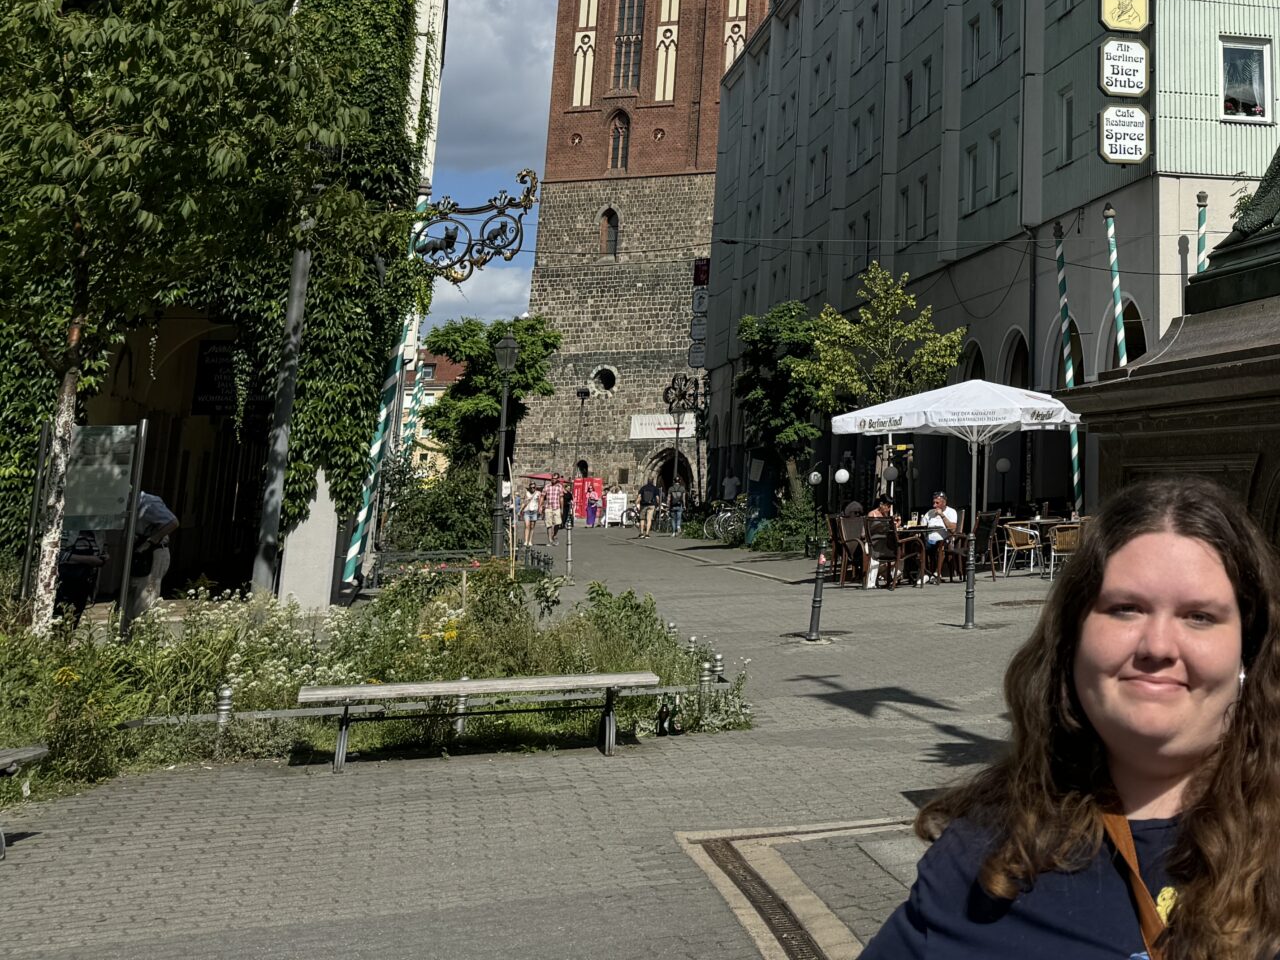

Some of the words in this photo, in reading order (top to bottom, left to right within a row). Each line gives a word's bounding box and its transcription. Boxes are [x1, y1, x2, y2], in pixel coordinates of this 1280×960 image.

[1116, 43, 1133, 53] Alt-
[1105, 52, 1144, 64] Berliner
[1110, 64, 1139, 77] Bier
[1105, 76, 1144, 89] Stube
[1105, 117, 1145, 128] Restaurant
[1105, 129, 1145, 143] Spree
[1108, 143, 1143, 156] Blick
